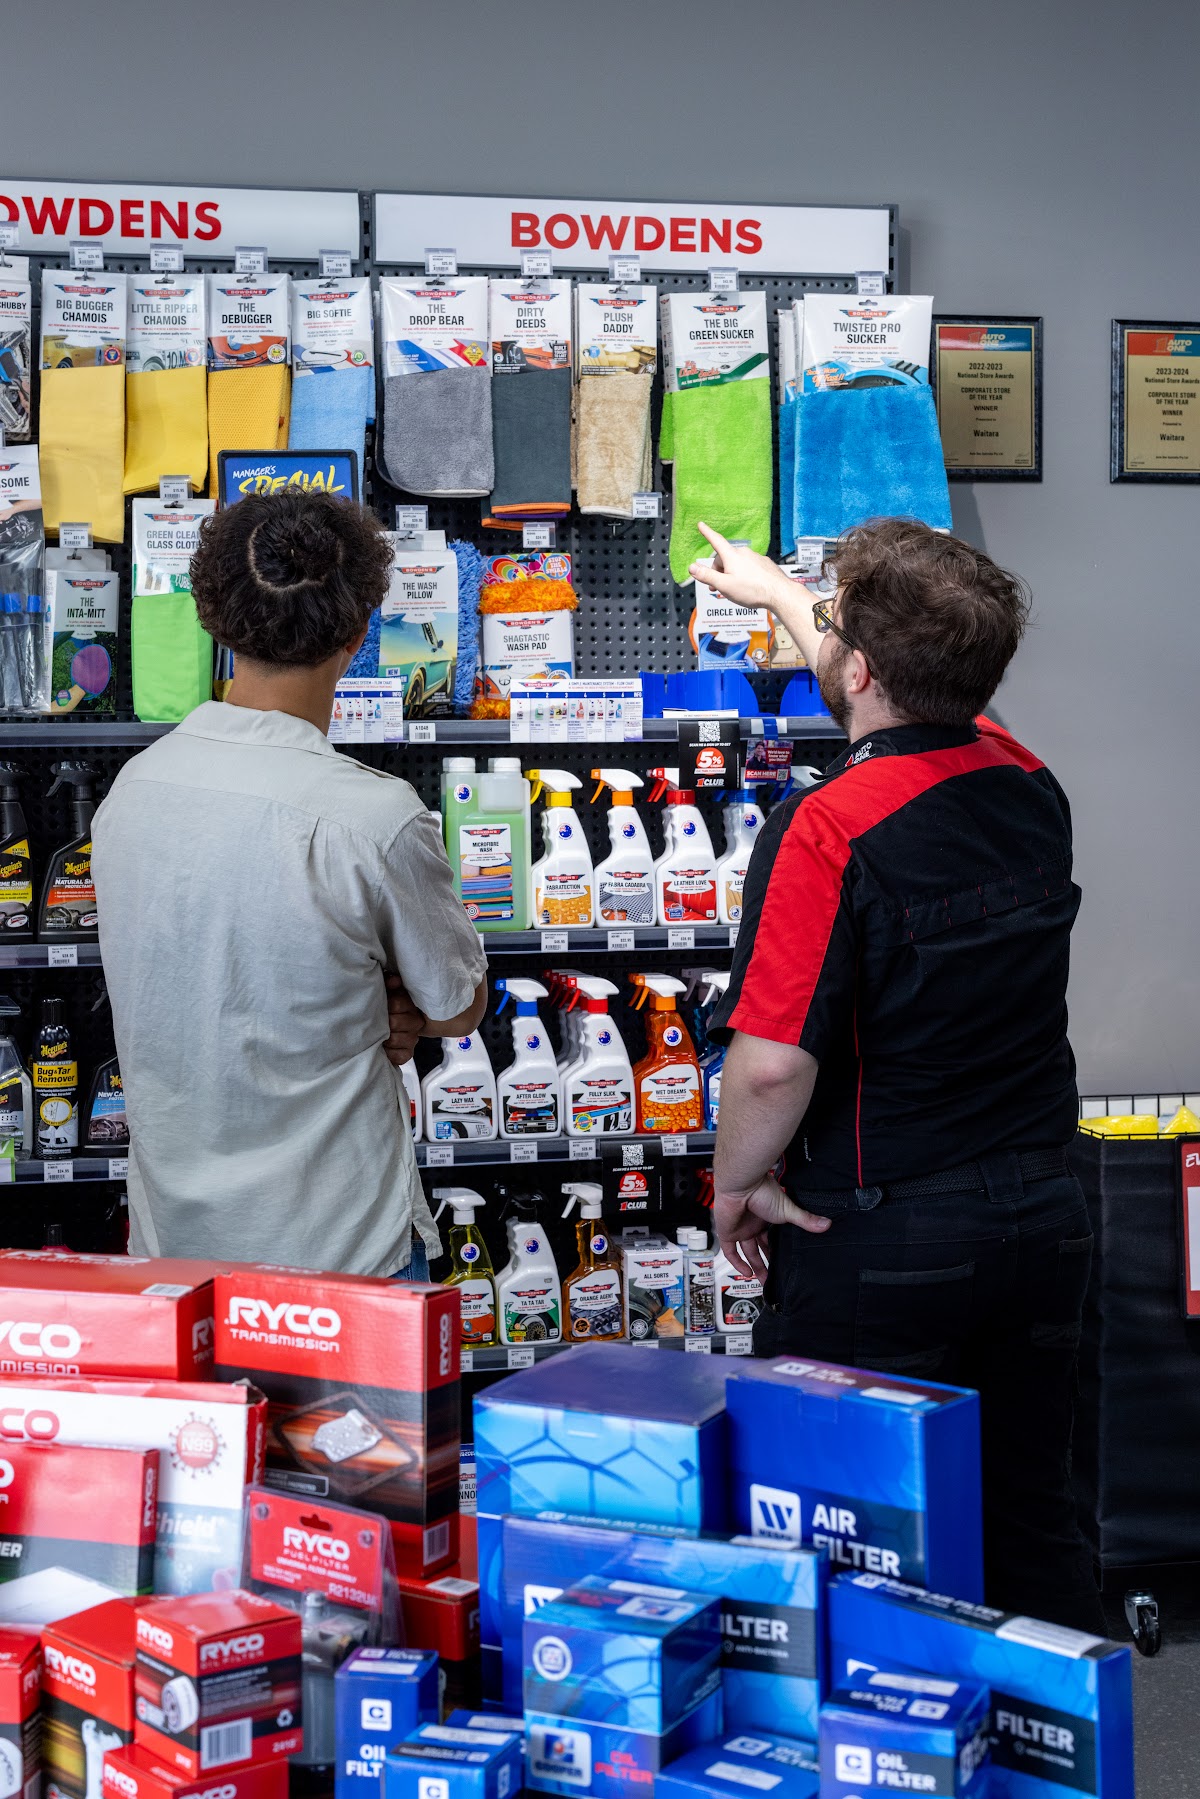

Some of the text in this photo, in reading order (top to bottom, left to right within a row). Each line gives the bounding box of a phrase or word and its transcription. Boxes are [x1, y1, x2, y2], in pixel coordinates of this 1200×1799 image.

[511, 212, 763, 254] BOWDENS
[56, 300, 114, 311] BIG BUGGER
[131, 303, 198, 314] LITTLE RIPPER
[238, 303, 256, 312] THE
[427, 304, 446, 314] THE
[62, 312, 107, 323] CHAMOIS
[307, 308, 352, 319] BIG SOFTIE
[517, 307, 544, 317] DIRTY
[603, 312, 633, 323] PLUSH
[143, 315, 187, 325] CHAMOIS
[221, 314, 272, 324] DEBUGGER
[409, 315, 465, 326] DROP BEAR
[516, 318, 546, 328] DEEDS
[704, 317, 739, 328] THE BIG
[603, 322, 634, 334] DADDY
[833, 323, 901, 333] TWISTED PRO
[689, 329, 755, 341] GREEN SUCKER
[846, 334, 887, 344] SUCKER
[968, 363, 1003, 371] 2022-2023
[957, 372, 979, 380] National
[973, 429, 999, 437] Waitara
[232, 465, 277, 479] MANAGER'S
[0, 477, 30, 488] SOME
[146, 530, 174, 539] GREEN
[147, 541, 173, 550] GLASS
[402, 582, 438, 591] THE WASH
[406, 591, 433, 599] PILLOW
[80, 597, 94, 606] THE
[67, 608, 105, 618] INTA-MITT
[706, 607, 759, 617] CIRCLE WORK
[503, 634, 550, 643] SHAGTASTIC
[506, 642, 547, 651] WASH PAD
[855, 742, 873, 759] AUTO
[698, 751, 722, 768] 5%
[853, 750, 870, 764] ONE
[40, 1041, 68, 1058] Meguiar's
[37, 1068, 54, 1077] Bug
[58, 1067, 72, 1075] Tar
[37, 1074, 75, 1083] Remover
[620, 1175, 645, 1191] 5%
[579, 1294, 599, 1302] ORANGE
[229, 1296, 341, 1338] RYCO
[230, 1328, 340, 1353] TRANSMISSION
[439, 1313, 450, 1376] RYCO
[143, 1467, 155, 1527] RYCO
[812, 1503, 857, 1537] AIR
[612, 1520, 637, 1530] AIR
[644, 1522, 687, 1535] FILTER
[283, 1526, 351, 1562] RYCO
[283, 1549, 350, 1572] FUEL FILTER
[812, 1533, 901, 1578] FILTER
[136, 1618, 174, 1650] RYCO
[720, 1614, 789, 1643] ILTER
[200, 1633, 265, 1662] RYCO
[221, 1650, 265, 1667] FILTER
[44, 1646, 97, 1687] RYCO
[368, 1706, 384, 1719] C
[996, 1710, 1075, 1754] FILTER
[359, 1744, 386, 1760] OIL
[609, 1751, 638, 1768] OIL
[876, 1752, 908, 1771] OIL
[103, 1762, 139, 1795] RYCO
[594, 1761, 654, 1785] FILTER
[876, 1771, 937, 1792] FILTER
